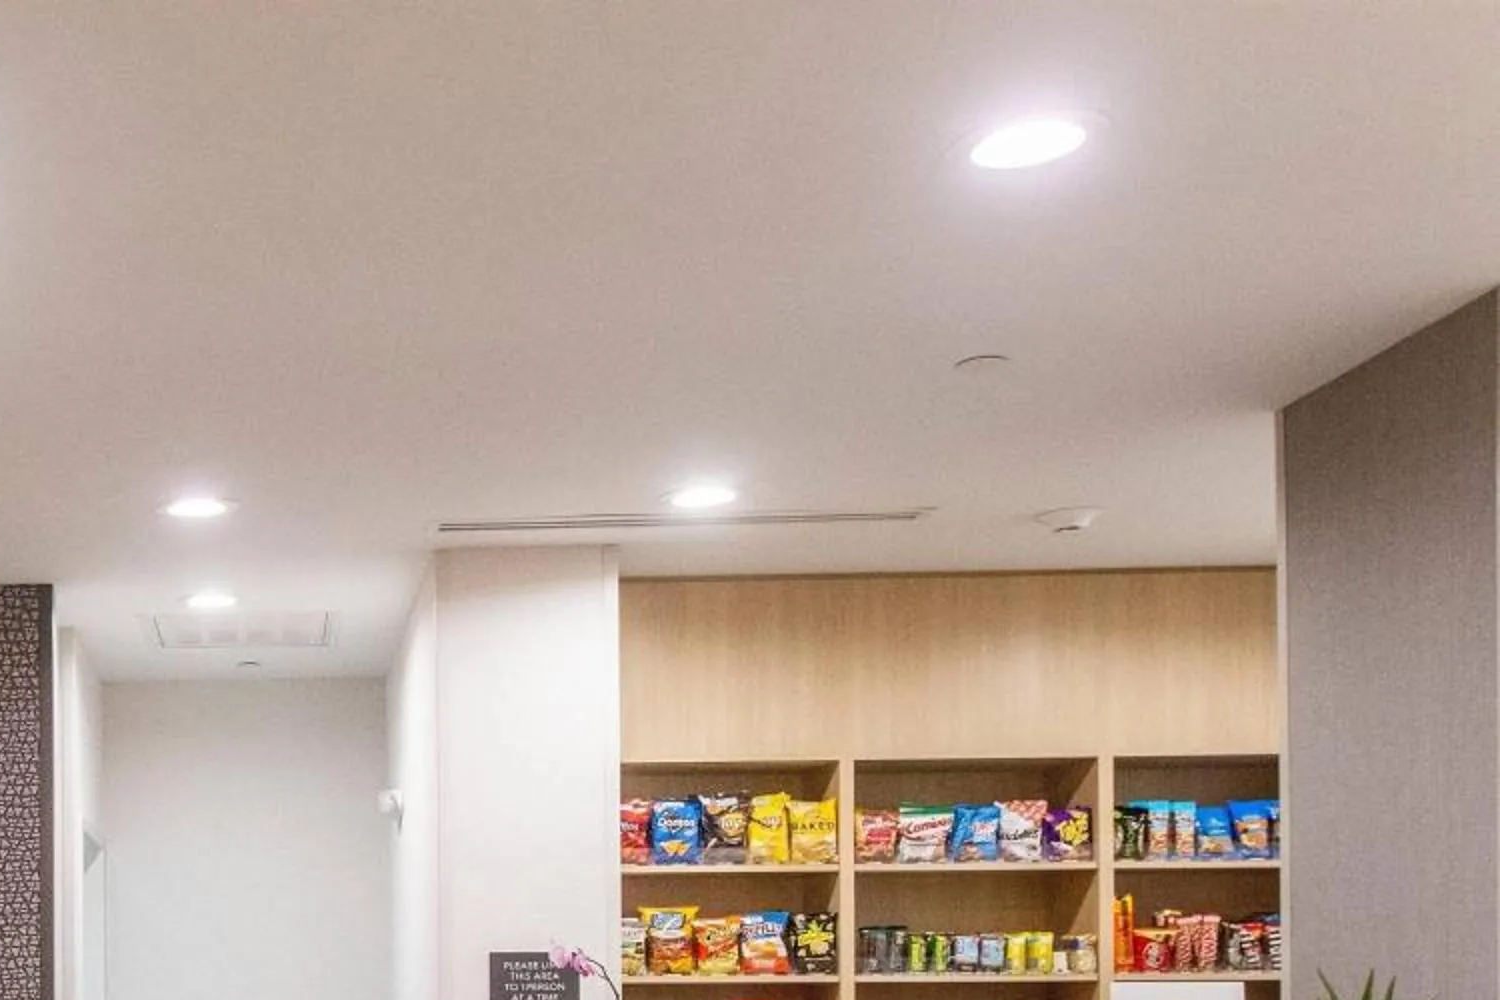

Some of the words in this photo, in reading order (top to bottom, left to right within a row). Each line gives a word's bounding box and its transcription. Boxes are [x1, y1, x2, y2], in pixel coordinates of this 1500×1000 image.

[503, 961, 539, 970] PLEASE
[511, 971, 531, 980] THIS
[533, 972, 560, 980] AREA
[504, 983, 519, 991] TO
[510, 993, 524, 1000] AT
[536, 993, 559, 1000] TIME
